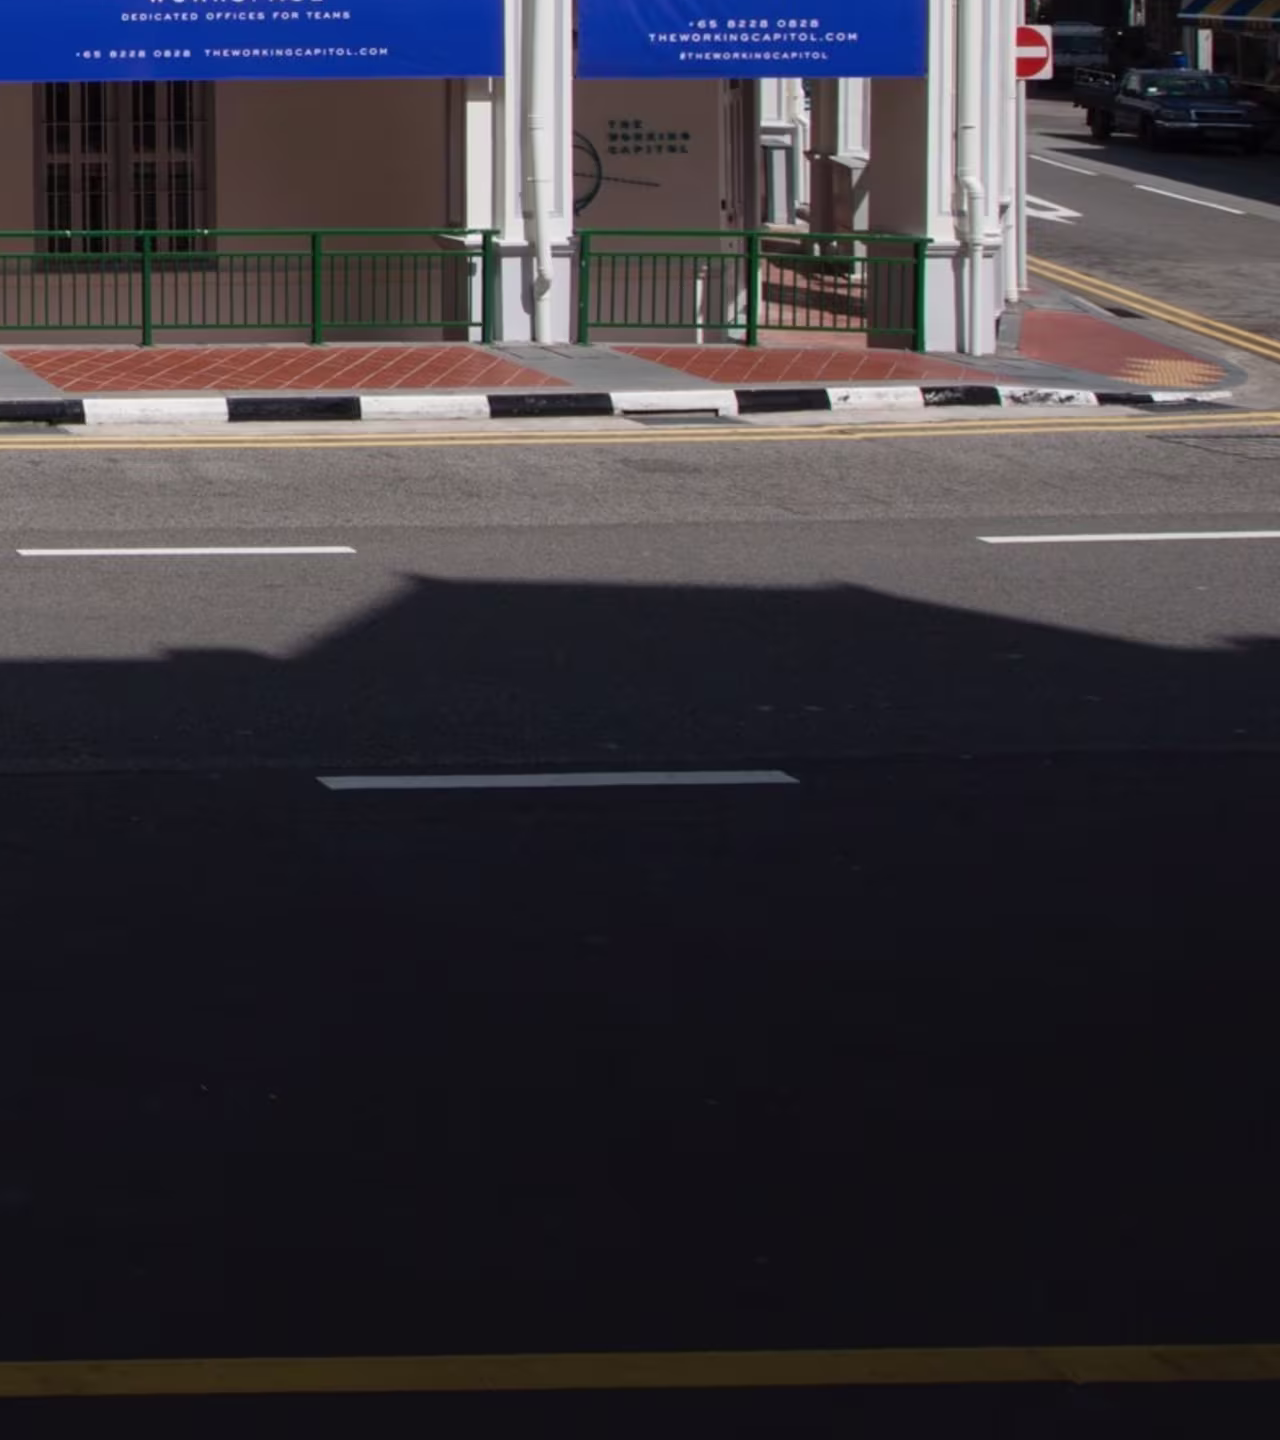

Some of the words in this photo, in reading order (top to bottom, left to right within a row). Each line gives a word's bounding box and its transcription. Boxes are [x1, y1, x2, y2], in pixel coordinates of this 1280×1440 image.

[121, 11, 199, 22] DEDICATED
[205, 11, 265, 21] OFFICES
[272, 11, 299, 20] FOR
[306, 10, 351, 20] TEAMS
[648, 32, 858, 43] THEWORKINGCAPITOL.COM
[204, 47, 388, 58] THEWORKINGCAPITOL.COM
